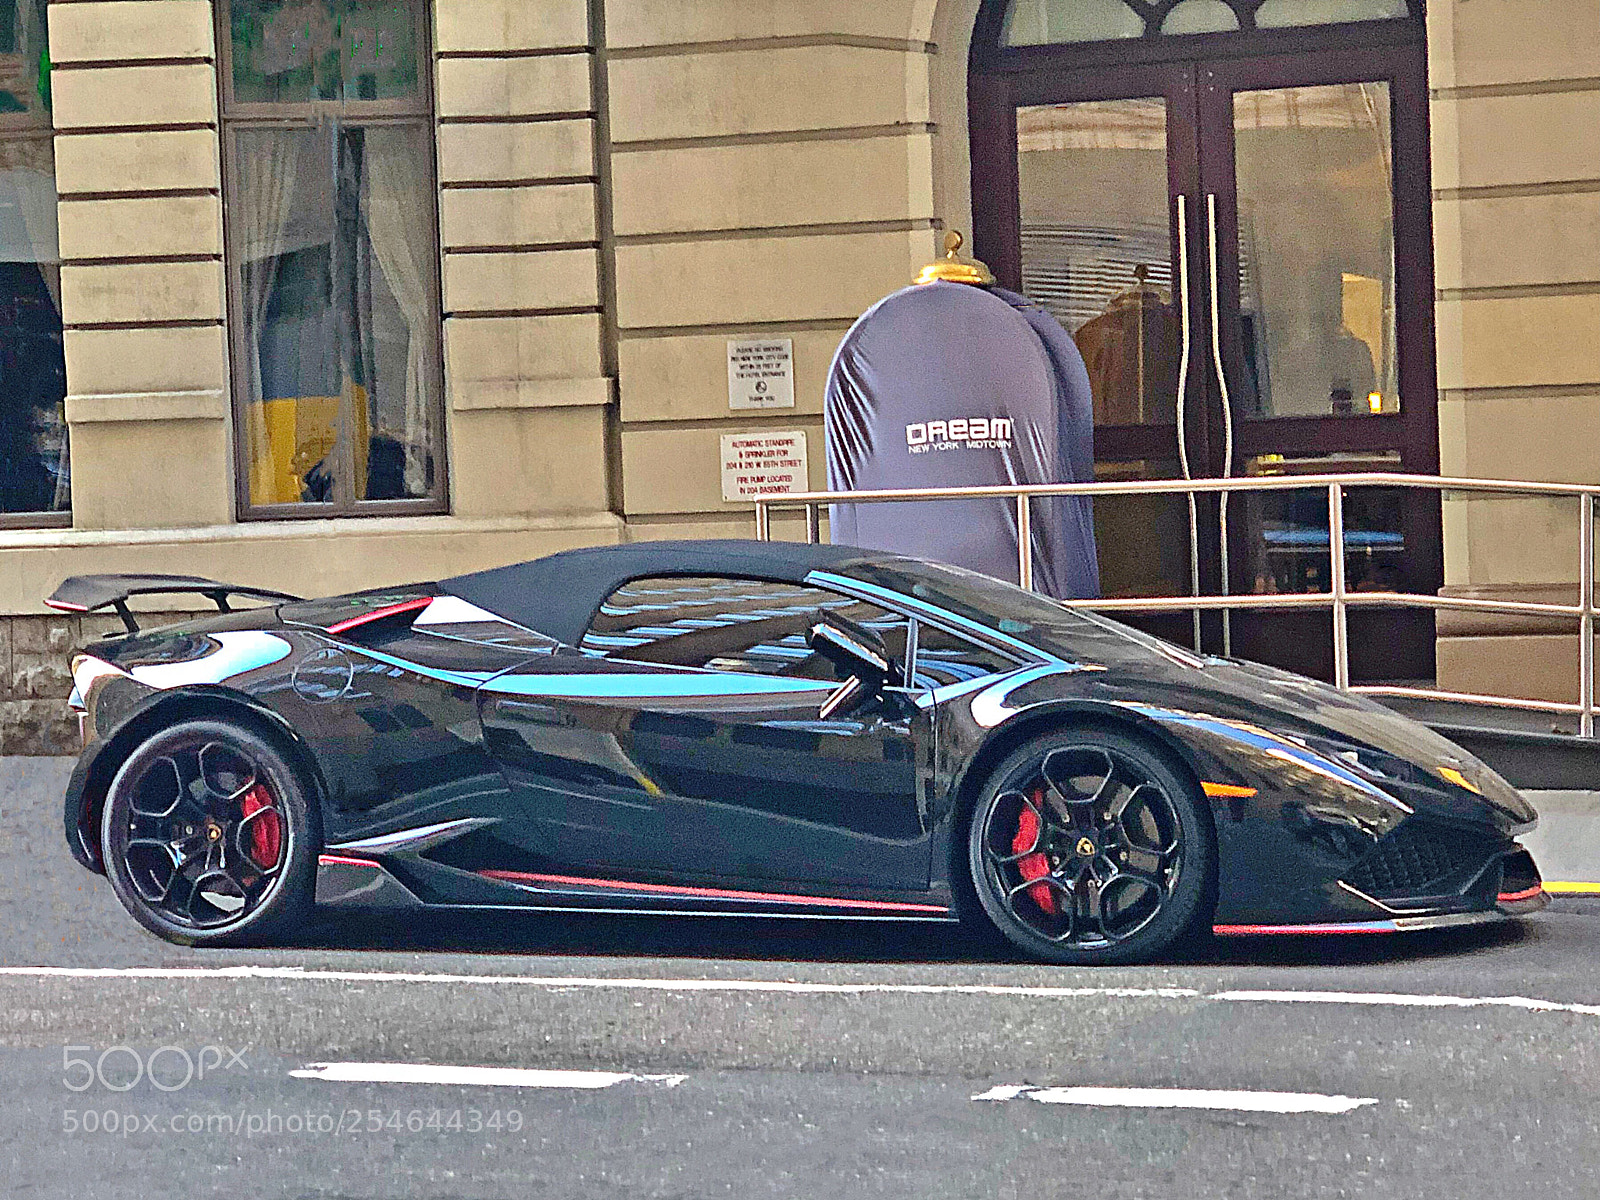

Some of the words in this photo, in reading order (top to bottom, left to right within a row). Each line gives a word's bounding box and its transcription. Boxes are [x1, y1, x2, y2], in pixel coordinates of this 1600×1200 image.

[732, 440, 763, 448] AUTOMATIC
[765, 439, 794, 447] STANDPIPE
[908, 445, 929, 454] NEW
[932, 441, 959, 451] YORK
[966, 440, 1011, 449] MIDTOWN
[745, 450, 775, 458] SPRINKLER
[737, 476, 749, 484] FIRE
[750, 475, 766, 483] PUMP
[767, 475, 793, 483] LOCATED
